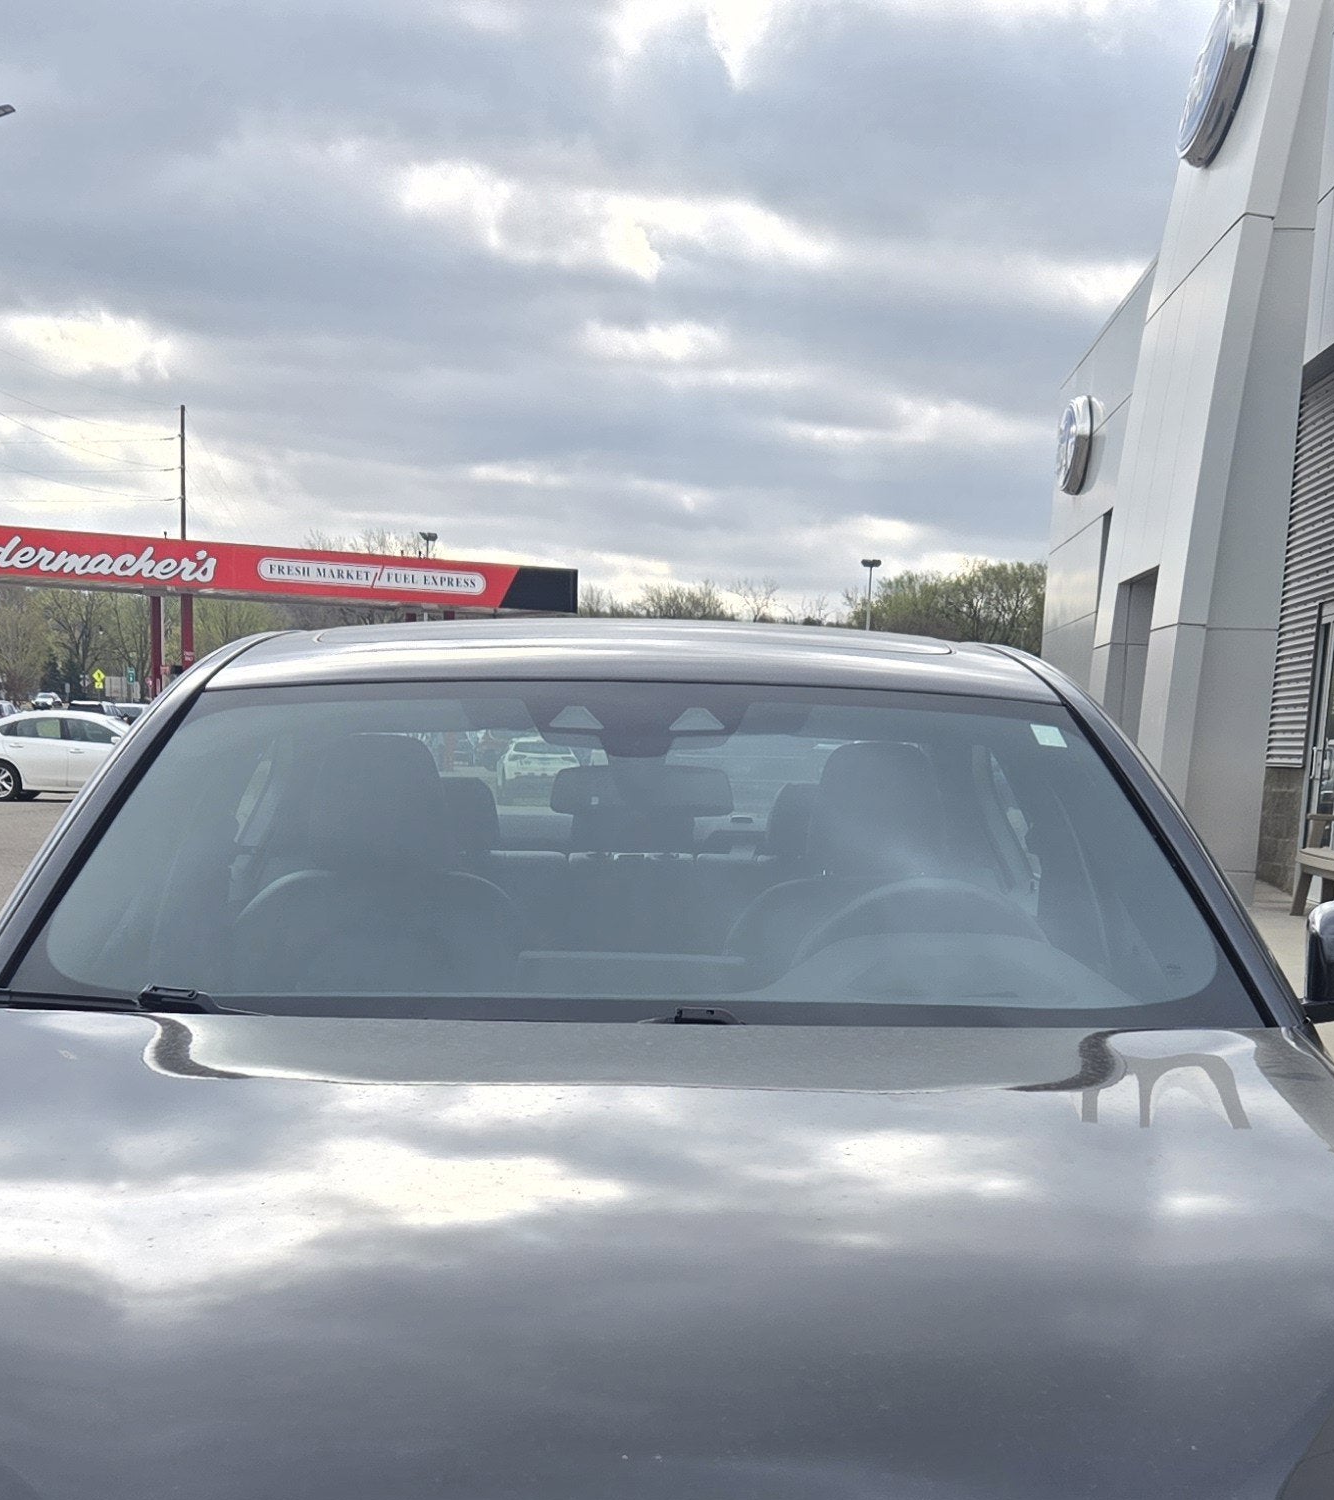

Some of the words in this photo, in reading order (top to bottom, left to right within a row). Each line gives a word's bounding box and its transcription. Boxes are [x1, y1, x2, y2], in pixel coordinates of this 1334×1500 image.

[269, 564, 310, 578] FRESH
[316, 567, 371, 581] MARKET
[386, 572, 417, 585] FUEL
[423, 574, 477, 589] EXPRESS
